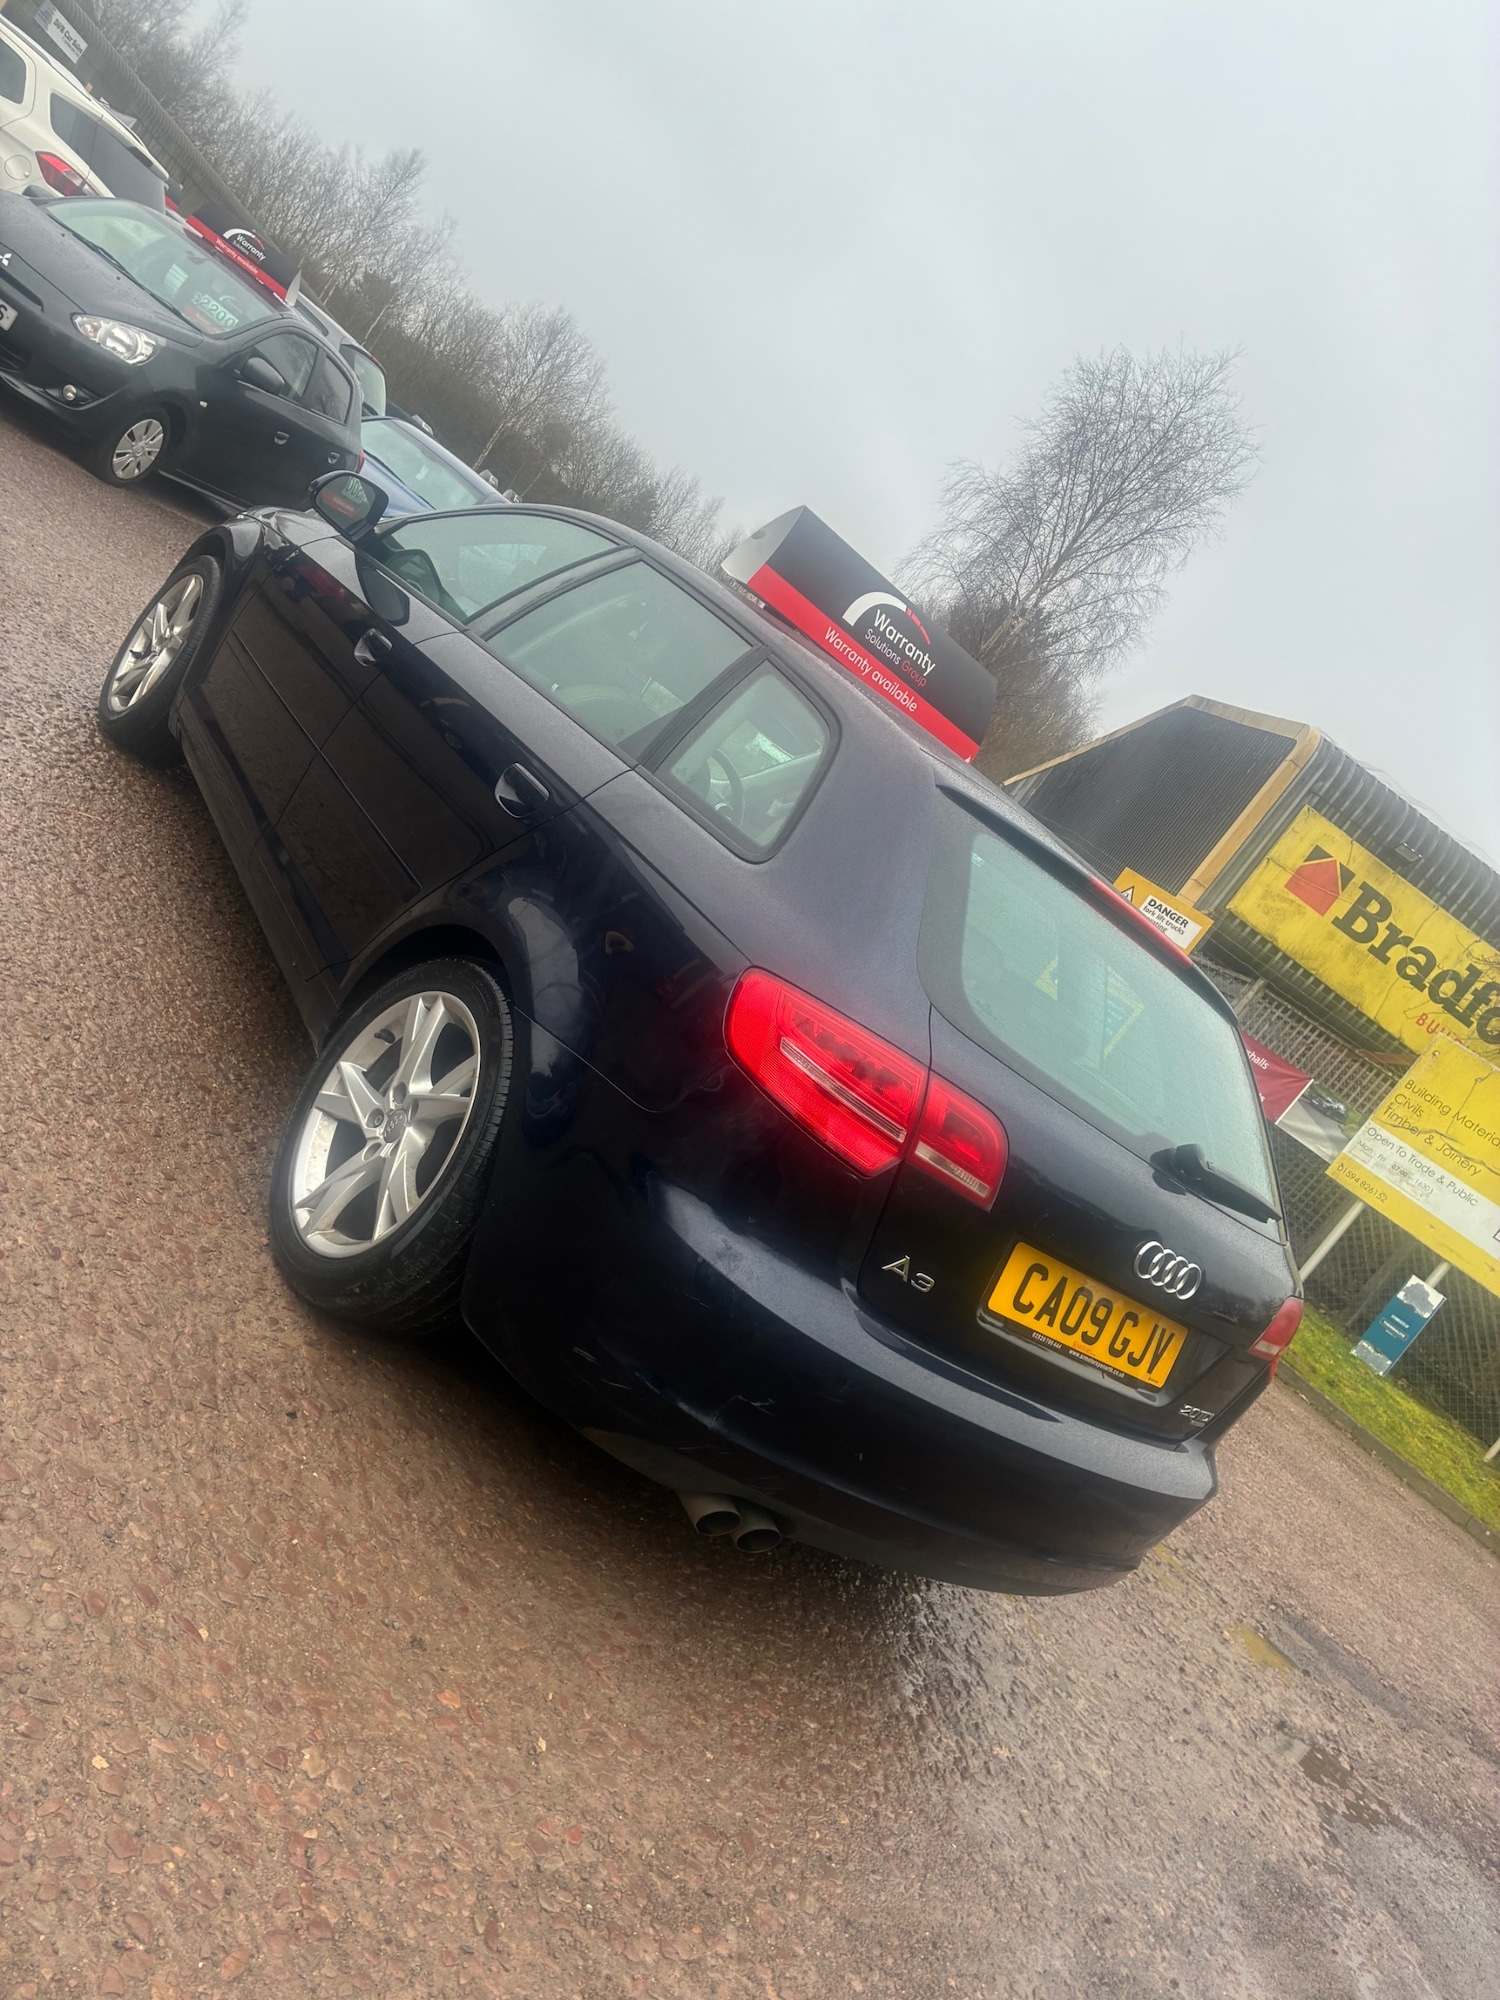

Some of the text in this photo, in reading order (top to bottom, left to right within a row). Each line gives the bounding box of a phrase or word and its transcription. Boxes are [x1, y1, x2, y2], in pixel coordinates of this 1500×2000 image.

[64, 30, 73, 42] Car
[216, 238, 237, 258] Warranty
[237, 254, 258, 274] available
[236, 234, 266, 261] Warranty
[865, 629, 927, 688] Solutions Group
[873, 609, 936, 676] Warranty
[825, 627, 918, 712] Warranty available
[1143, 905, 1185, 935] fork lift trucks
[1147, 898, 1189, 928] DANGER
[1394, 1093, 1424, 1118] Civils
[1405, 1079, 1452, 1116] Building
[1357, 1140, 1374, 1154] Mon
[1383, 1106, 1482, 1176] Timber & Joinery
[1367, 1127, 1478, 1206] Open To Trade & Public
[882, 1255, 935, 1292] A3
[1012, 1262, 1175, 1375] CA09 GJV
